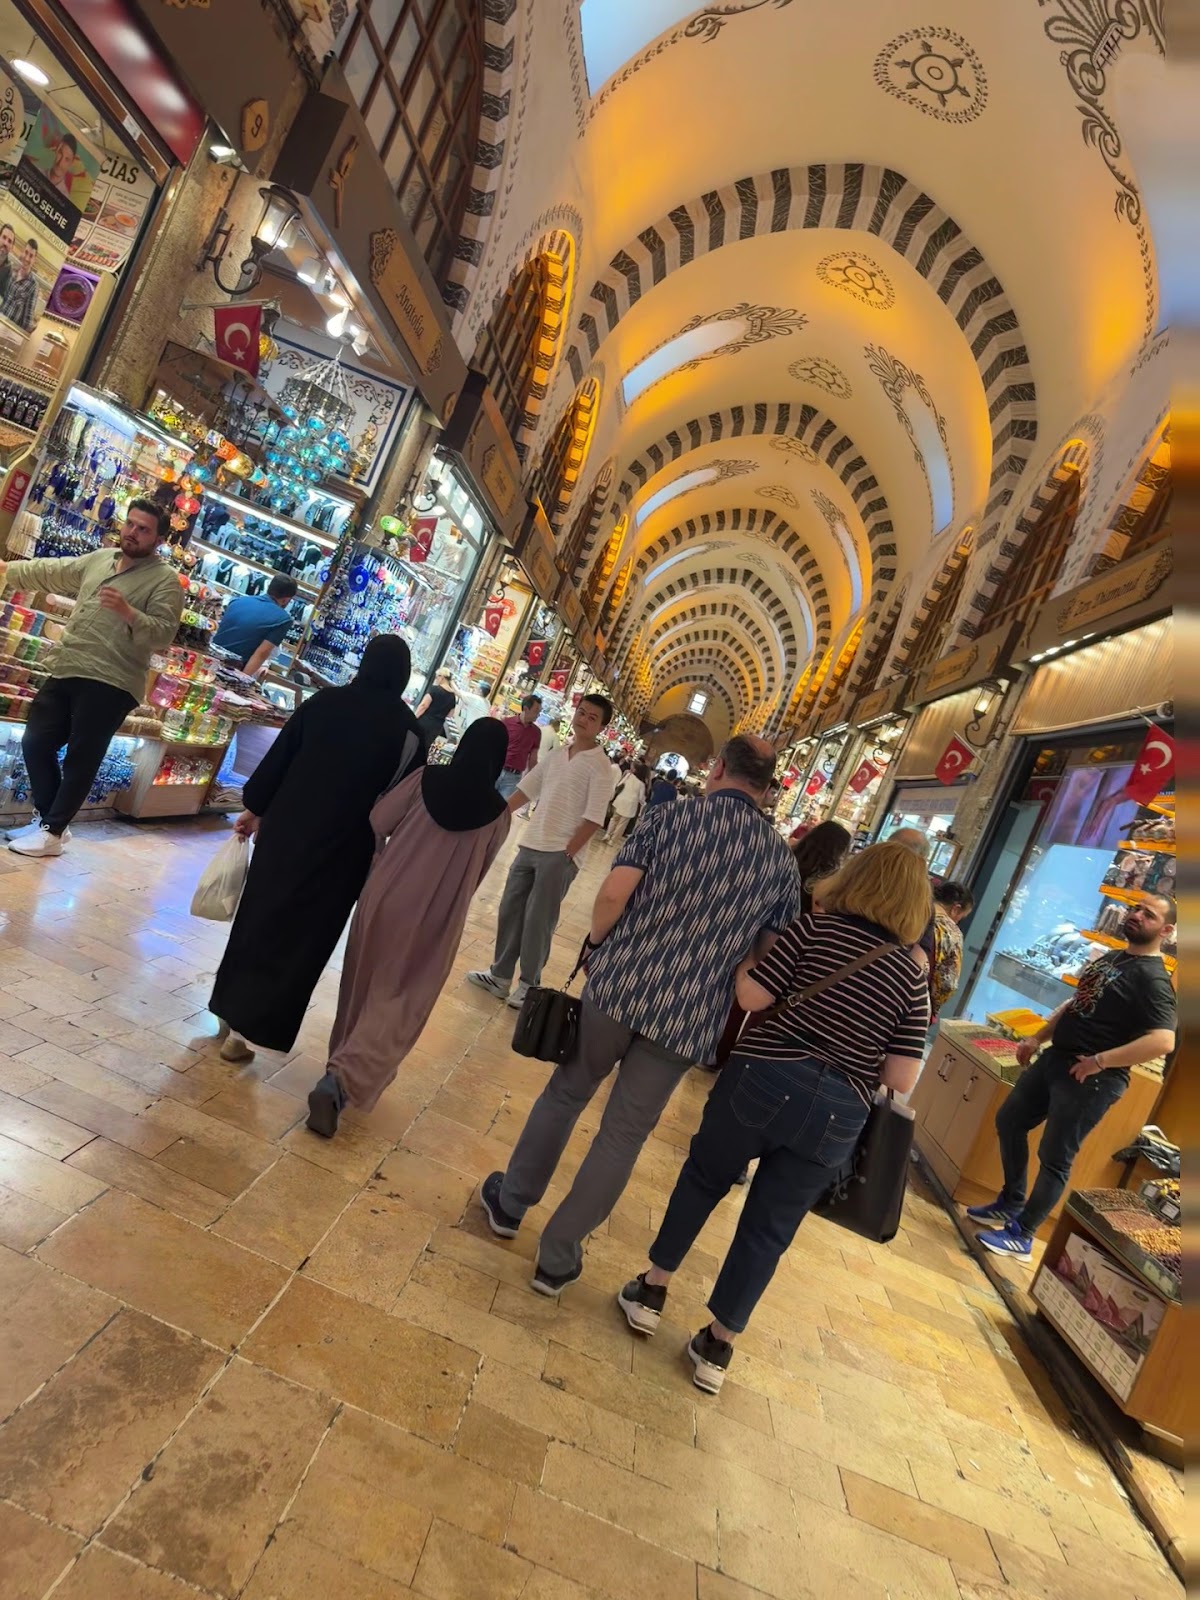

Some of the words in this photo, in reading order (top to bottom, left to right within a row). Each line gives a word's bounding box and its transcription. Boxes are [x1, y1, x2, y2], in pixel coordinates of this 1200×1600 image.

[251, 113, 263, 138] 9
[14, 175, 41, 204] MODO
[40, 200, 68, 229] SELFIE
